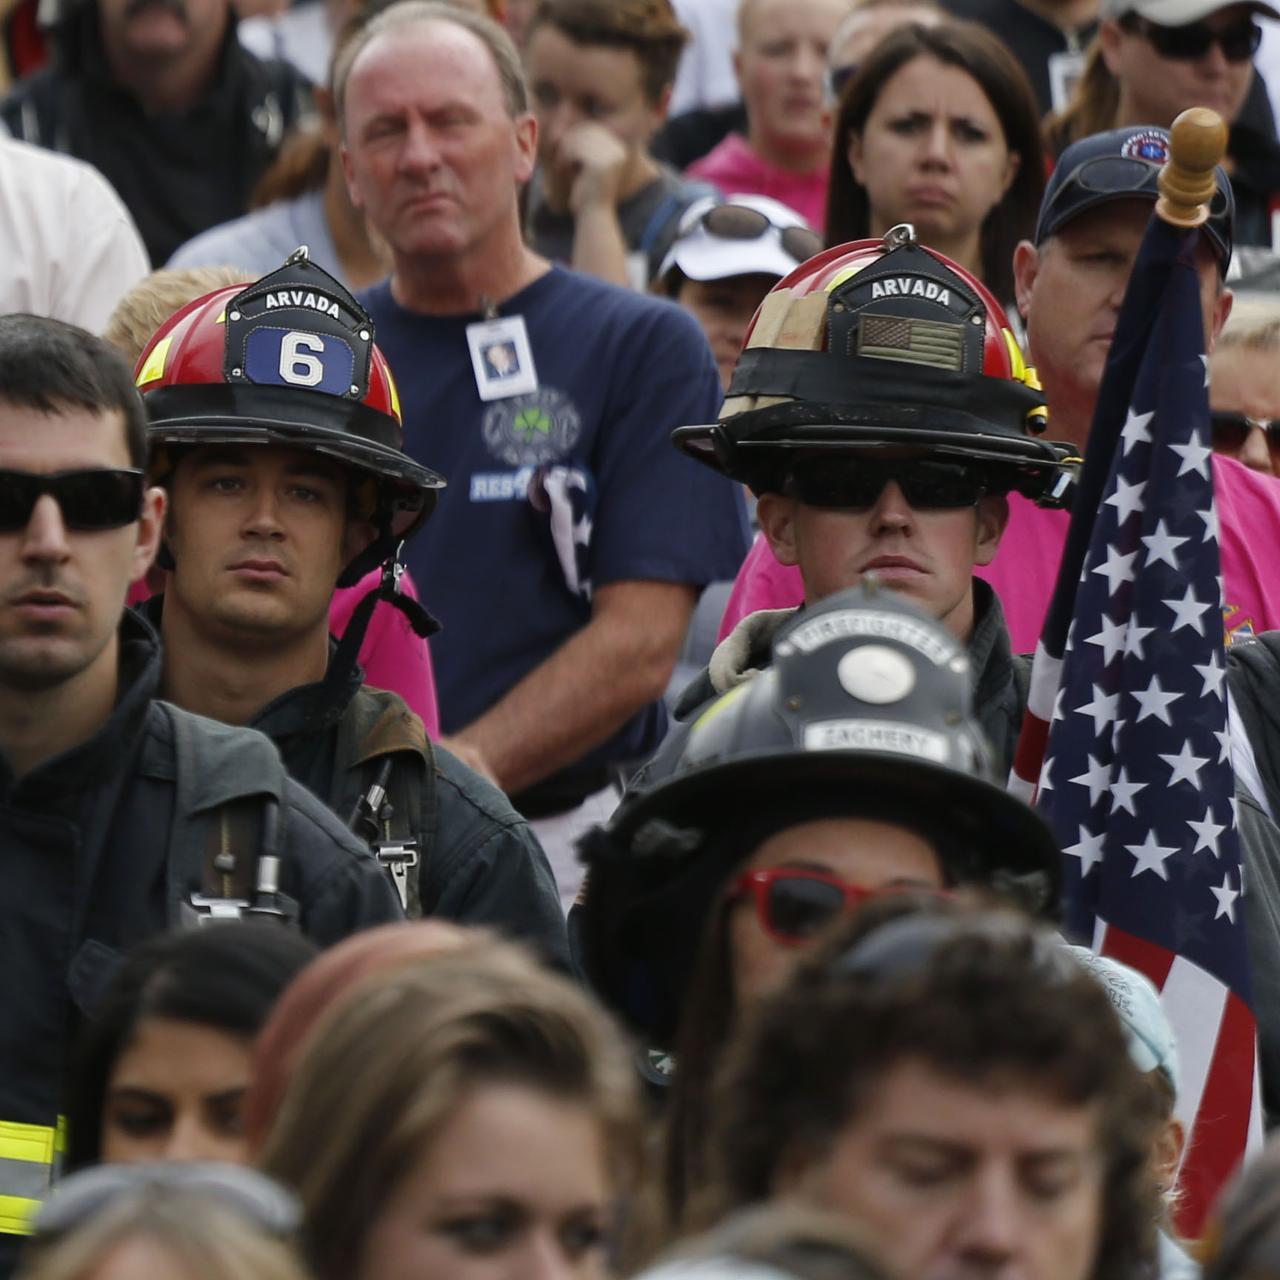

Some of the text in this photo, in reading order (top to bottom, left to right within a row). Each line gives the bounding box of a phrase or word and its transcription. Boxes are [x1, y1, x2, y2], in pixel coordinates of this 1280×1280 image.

[266, 291, 340, 319] ARVADA
[871, 278, 950, 306] ARVADA
[279, 331, 324, 387] 6
[794, 616, 946, 660] FIREFIGHTER
